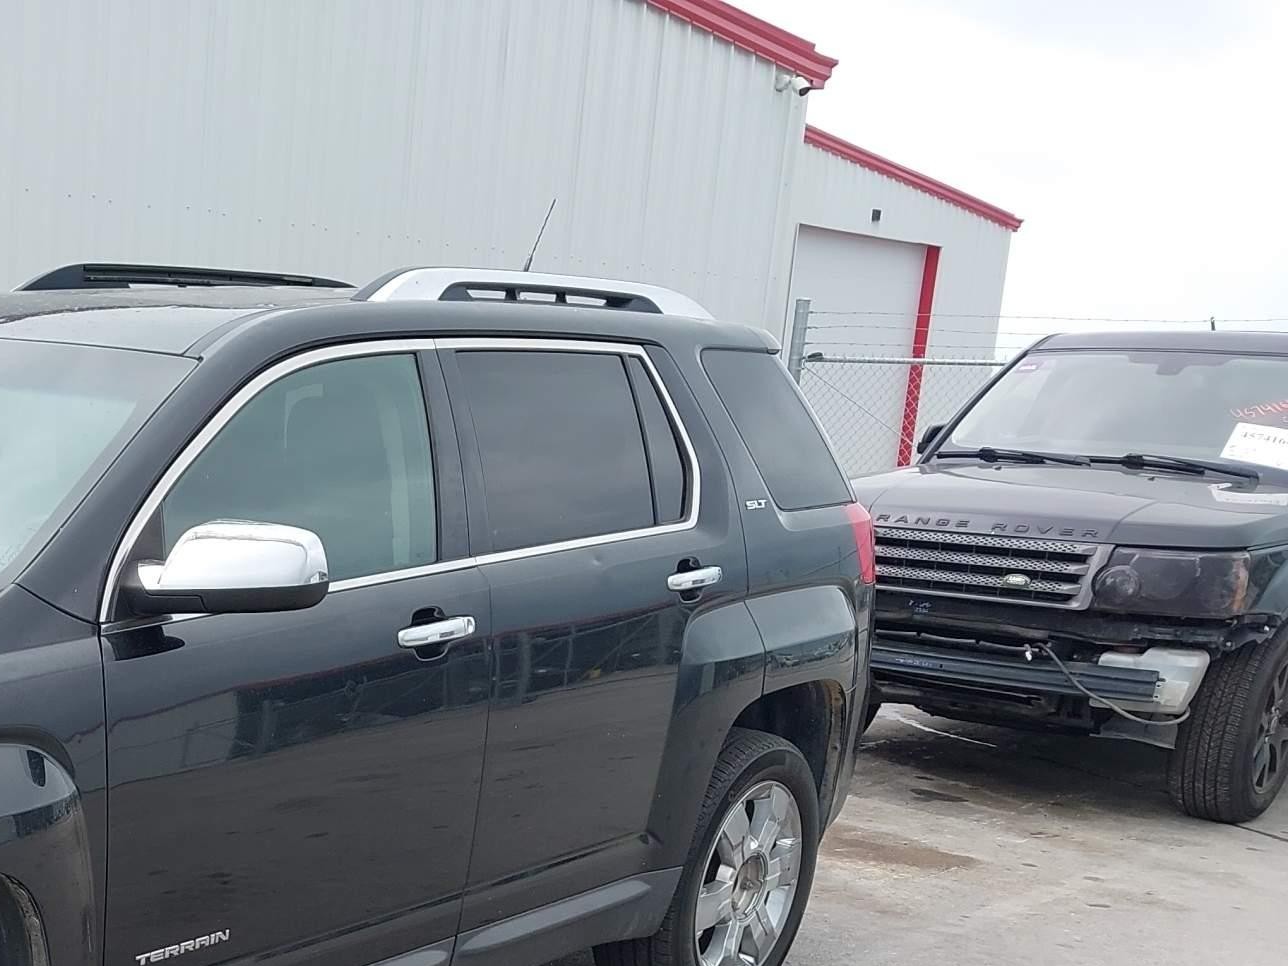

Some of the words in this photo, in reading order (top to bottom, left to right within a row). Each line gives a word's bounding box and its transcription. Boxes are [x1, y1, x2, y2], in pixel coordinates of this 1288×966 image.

[745, 499, 767, 510] SLT
[876, 514, 970, 527] RANGE
[992, 523, 1099, 538] ROVER
[135, 929, 230, 966] TERRAIN
